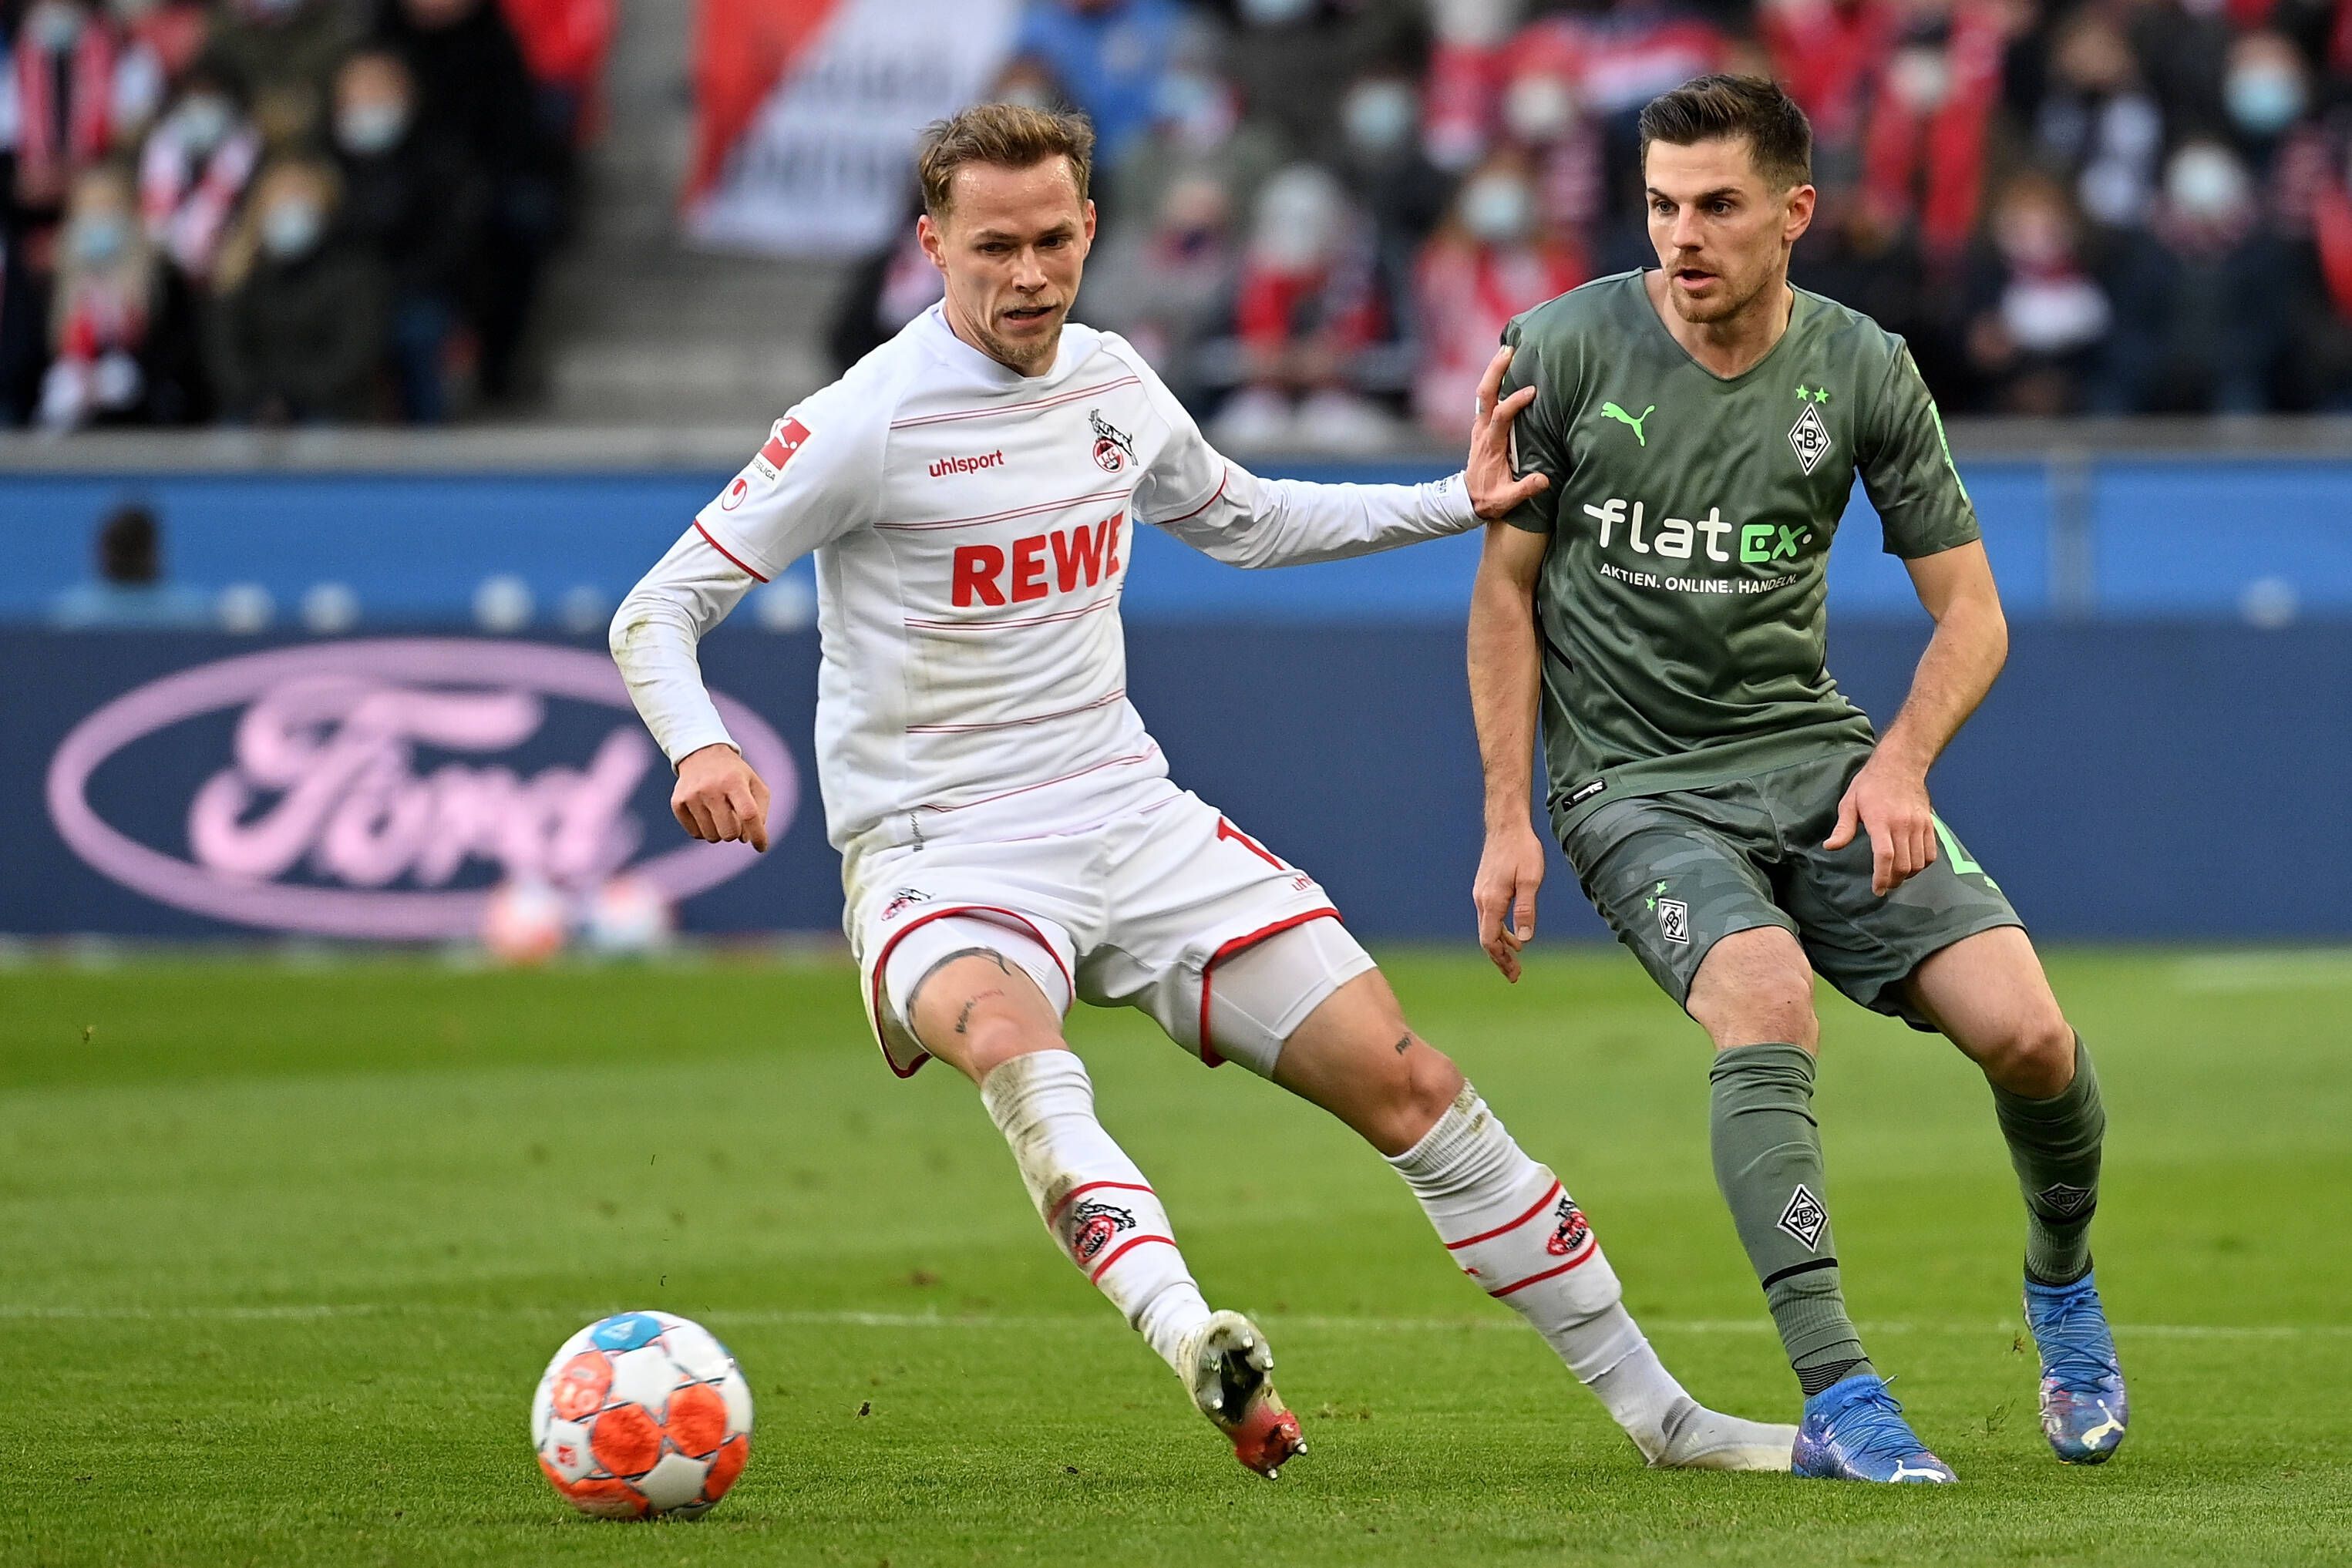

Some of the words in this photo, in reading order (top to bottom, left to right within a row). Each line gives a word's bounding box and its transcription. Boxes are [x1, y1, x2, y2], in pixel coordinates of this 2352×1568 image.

[928, 449, 1004, 477] uhlsport
[952, 510, 1124, 607] REWE
[1600, 563, 1661, 589] AKTIEN.
[1665, 577, 1734, 594] ONLINE.
[1738, 574, 1797, 594] HANDELN.
[191, 680, 651, 887] Ford
